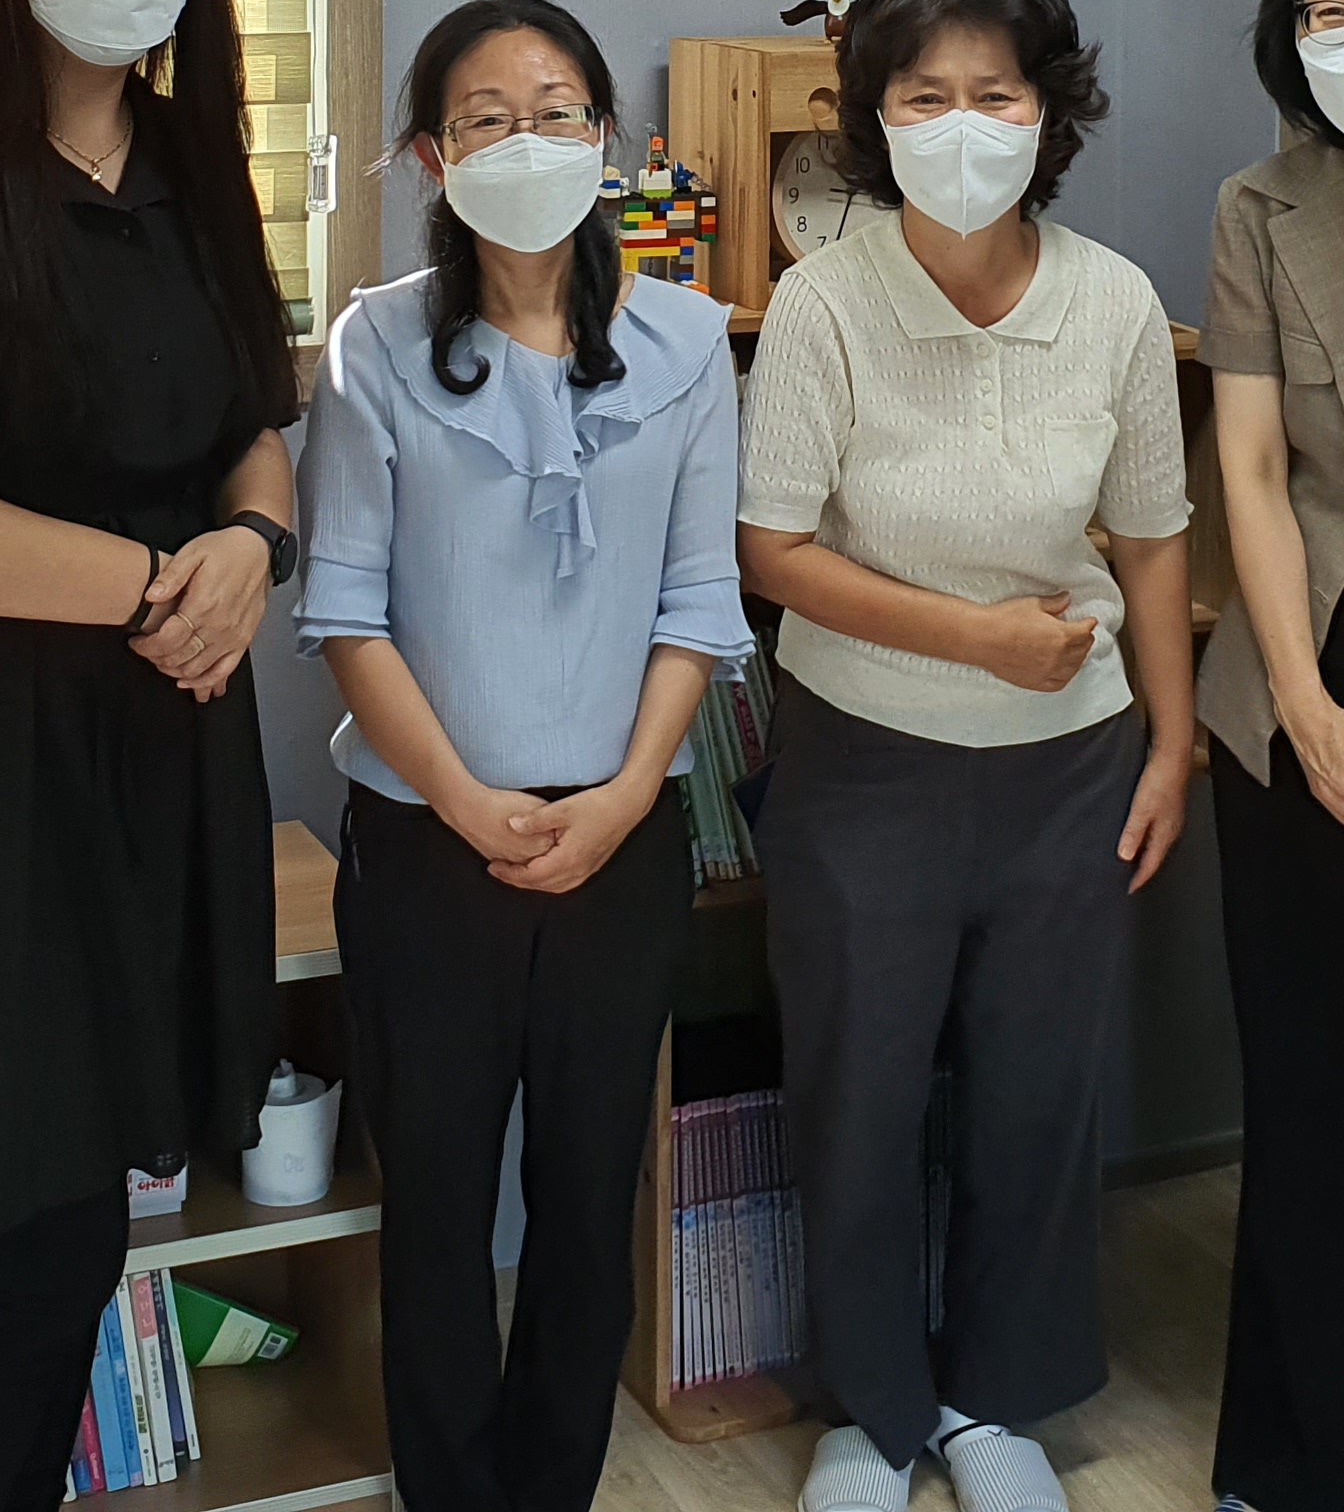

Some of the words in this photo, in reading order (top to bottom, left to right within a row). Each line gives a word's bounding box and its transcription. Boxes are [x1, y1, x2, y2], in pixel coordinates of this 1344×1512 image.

[794, 156, 811, 175] 10
[788, 186, 799, 205] 9
[796, 215, 808, 233] 8
